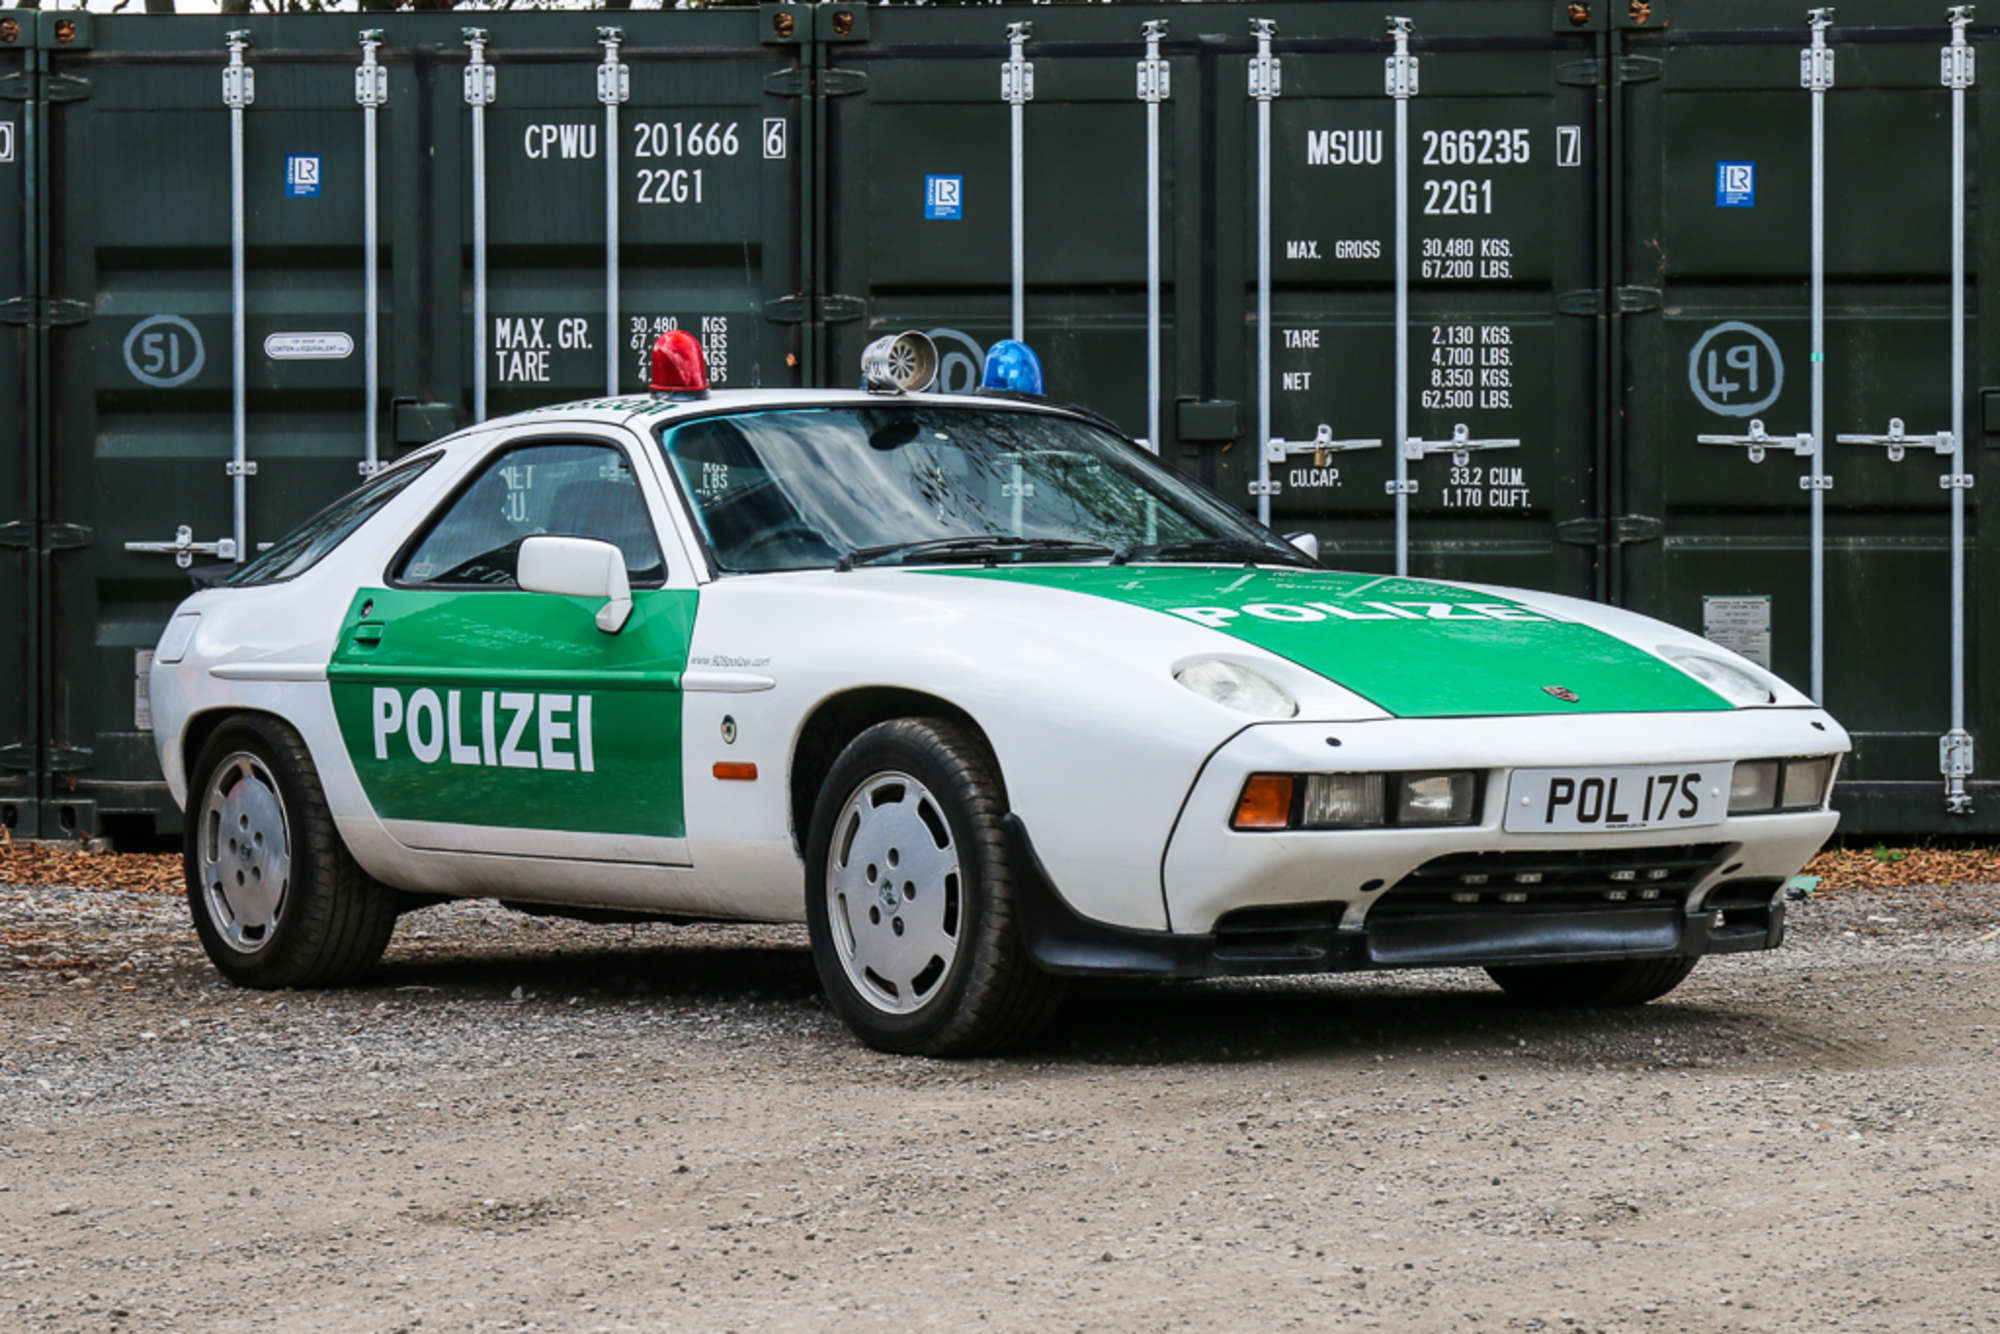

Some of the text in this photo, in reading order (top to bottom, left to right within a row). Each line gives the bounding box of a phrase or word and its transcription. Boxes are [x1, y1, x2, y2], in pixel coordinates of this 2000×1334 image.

[525, 122, 783, 158] CPWU 201666 6
[1308, 129, 1576, 164] MSUU 266235 7
[637, 169, 702, 203] 22G1
[1424, 179, 1492, 214] 22G1
[1286, 238, 1513, 259] MAX. GROSS 30.480 KGS.
[1422, 260, 1513, 278] 67.200 LBS.
[496, 318, 551, 349] MAX.
[558, 318, 593, 349] GR.
[702, 316, 727, 333] KGS
[702, 334, 727, 350] LBS
[1283, 326, 1513, 348] TARE 2.130 KGS.
[143, 333, 181, 374] 51
[495, 351, 550, 382] TARE
[1432, 347, 1513, 366] 4.700 LBS.
[1283, 369, 1513, 390] NET 8.350 KGS.
[1708, 345, 1758, 400] 49
[1422, 390, 1513, 408] 62.500 LBS.
[1450, 468, 1482, 485] 33.2
[1442, 488, 1482, 506] 1.170
[373, 687, 595, 772] POLIZEI
[1546, 773, 1702, 824] POL 17S
